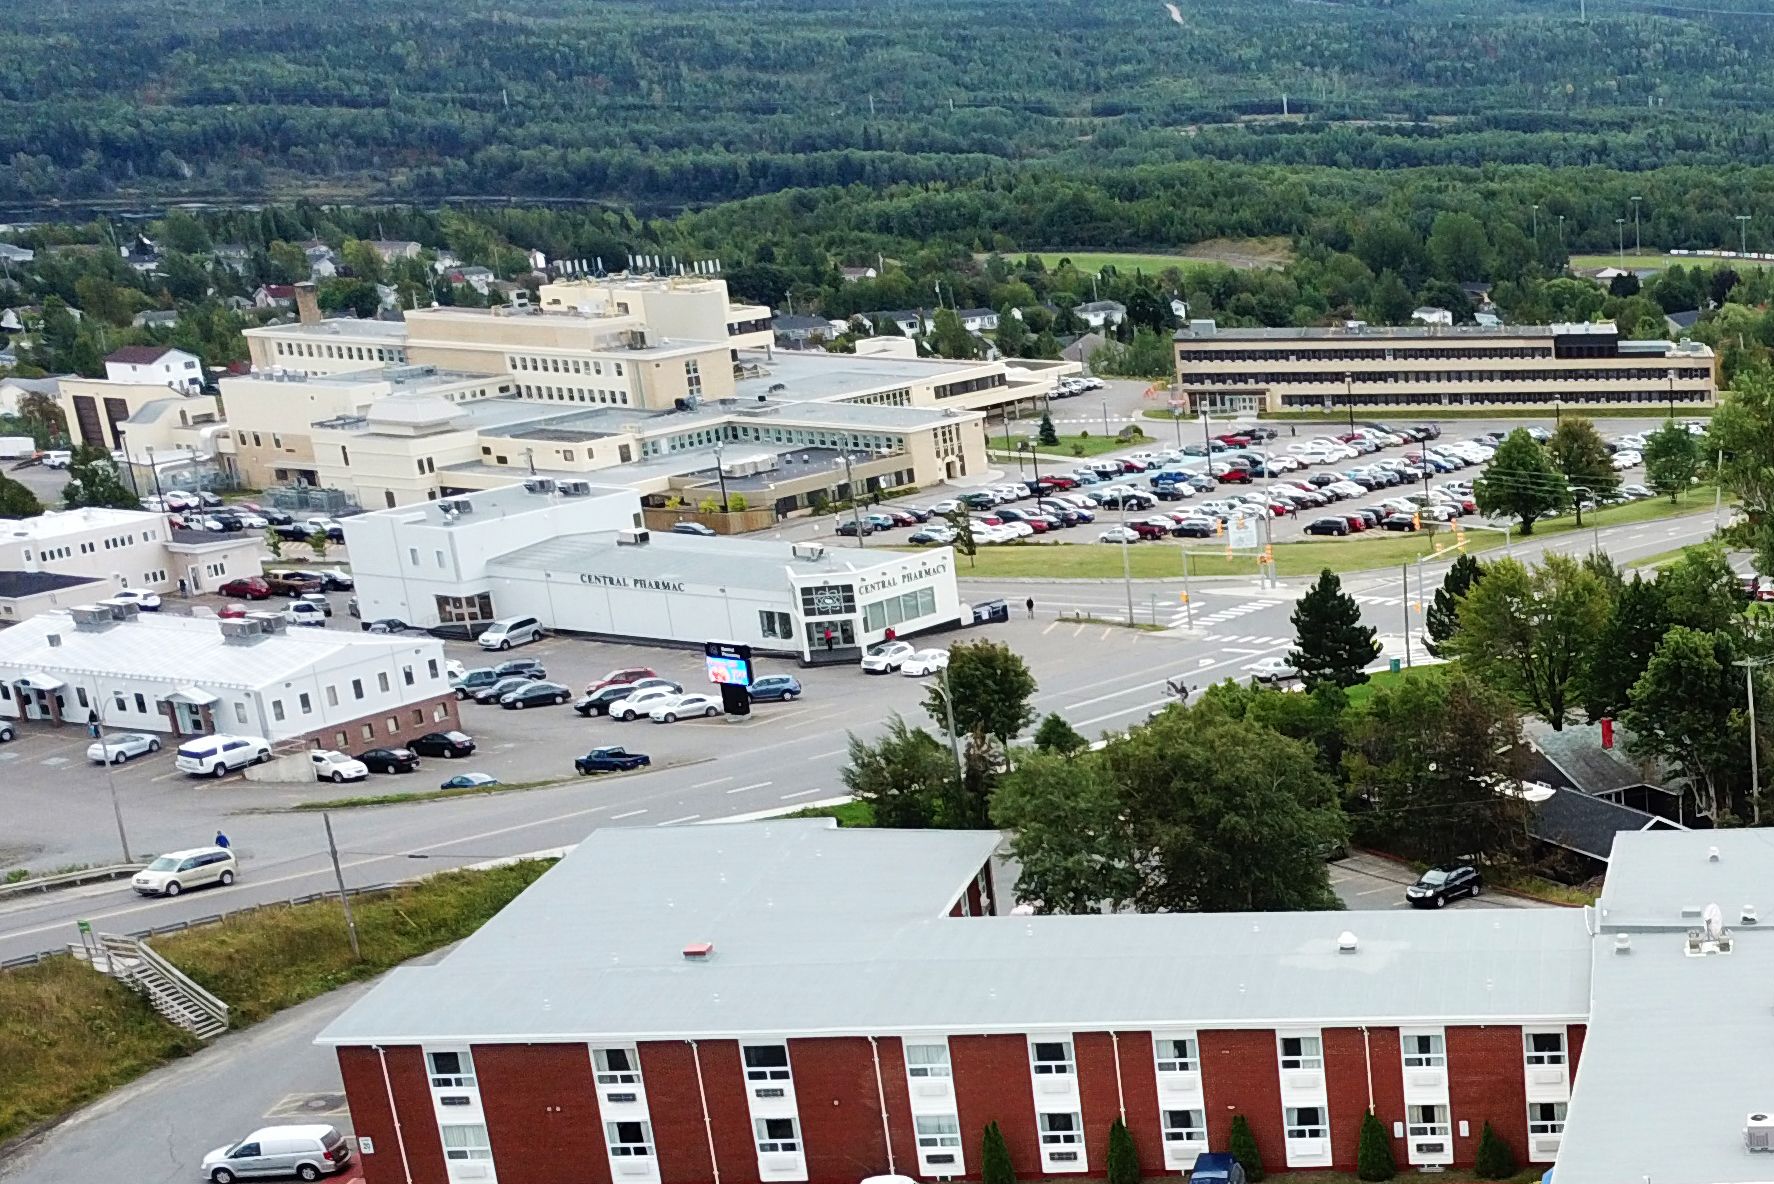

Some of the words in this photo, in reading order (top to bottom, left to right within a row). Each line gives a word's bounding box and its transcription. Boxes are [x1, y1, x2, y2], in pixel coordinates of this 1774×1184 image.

[580, 573, 629, 587] CENTRAL
[859, 577, 897, 595] CENTRAL
[901, 564, 946, 583] PHARMACY
